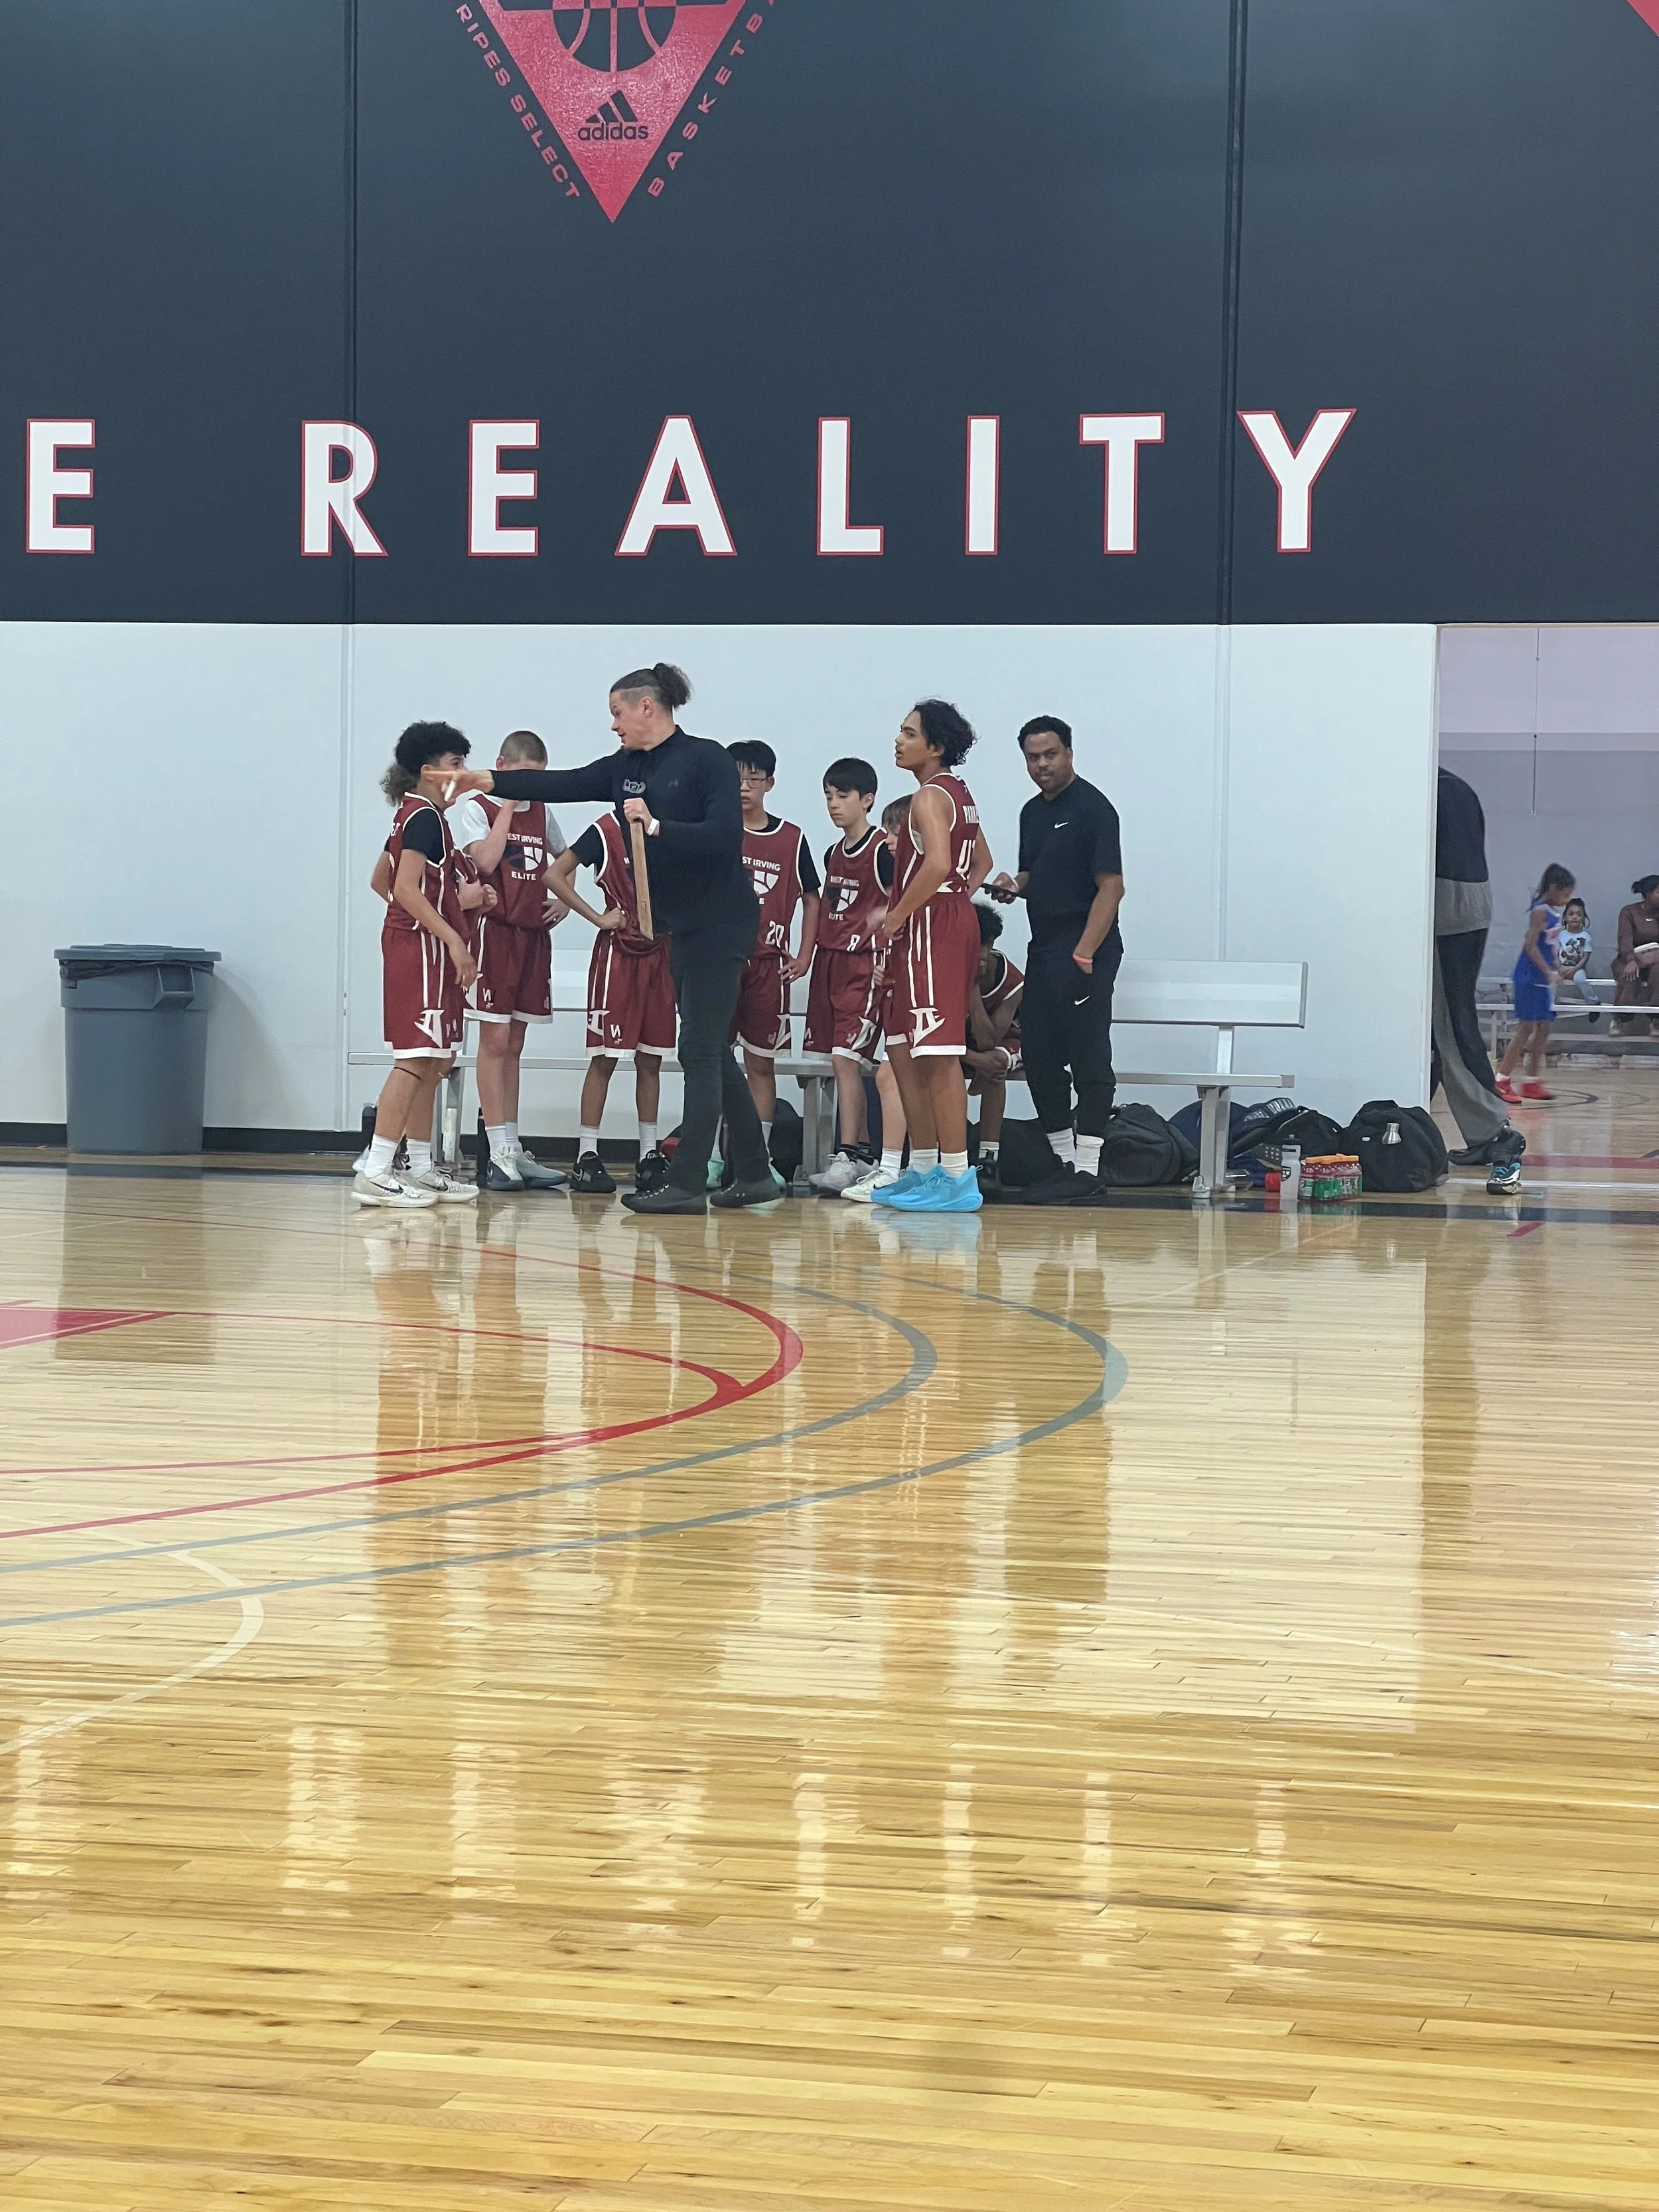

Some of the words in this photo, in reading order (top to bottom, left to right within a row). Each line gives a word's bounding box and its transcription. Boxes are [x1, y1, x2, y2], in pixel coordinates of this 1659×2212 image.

[647, 0, 774, 197] BASKETB
[577, 122, 649, 141] adidas
[510, 94, 580, 198] SELECT
[25, 417, 97, 555] E
[300, 407, 1358, 557] REALITY
[507, 832, 521, 841] EST
[521, 835, 543, 846] IRVING
[511, 871, 536, 881] ELITE
[753, 859, 780, 871] IRVING
[765, 921, 785, 948] 20
